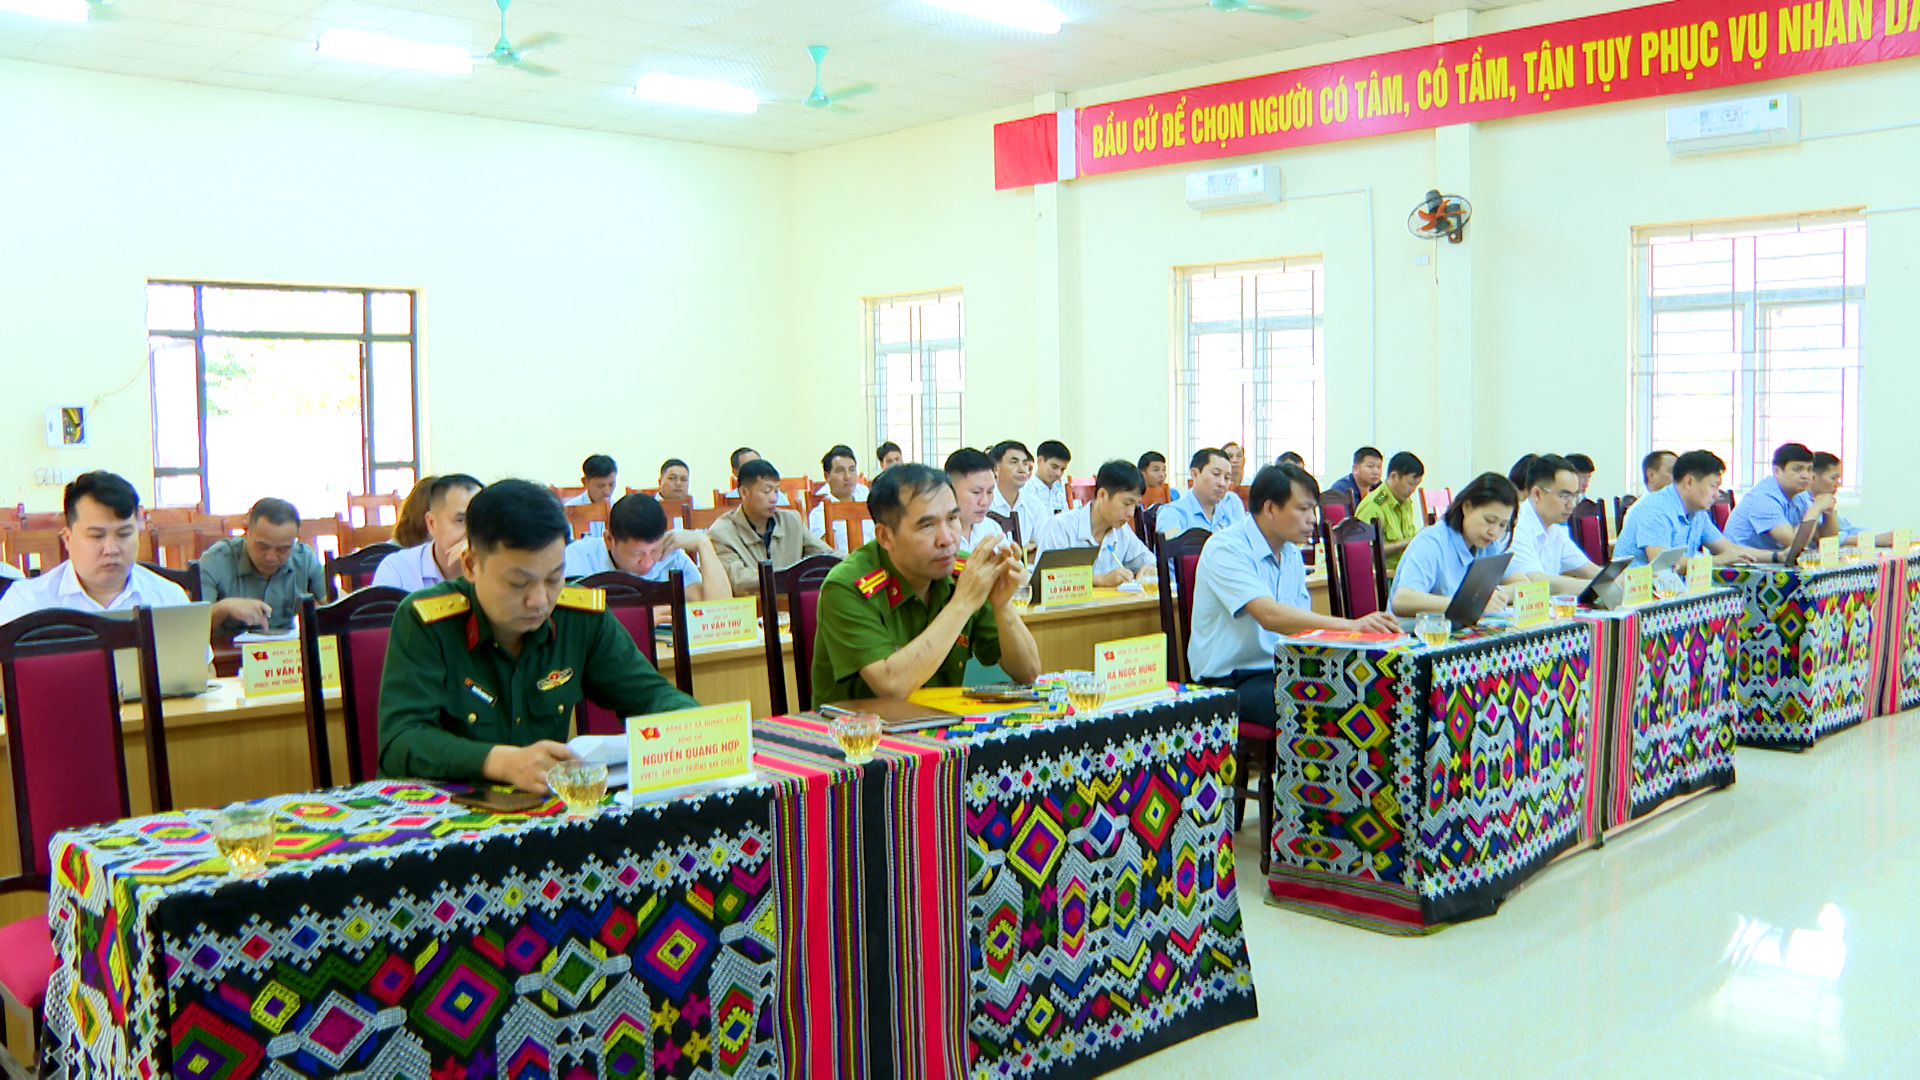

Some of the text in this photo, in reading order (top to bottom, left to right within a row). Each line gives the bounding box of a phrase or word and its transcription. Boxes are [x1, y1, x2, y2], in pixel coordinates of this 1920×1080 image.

[1093, 111, 1127, 159] BẦU
[1133, 104, 1158, 153] CỬ
[1162, 96, 1186, 148] ĐỂ
[1192, 106, 1243, 148] CHỌN
[1250, 82, 1313, 136] NGƯỜI
[1320, 76, 1348, 124] CÓ
[1354, 70, 1410, 118] TÂM,
[1417, 59, 1448, 110] CÓ
[1455, 46, 1515, 104] TẦM,
[1523, 40, 1574, 101] TẬN
[1582, 36, 1631, 92] TỤY
[1642, 21, 1718, 80] PHỤC
[1728, 12, 1767, 70] VỤ
[264, 669, 273, 677] VI
[276, 666, 294, 676] VĂN
[1118, 666, 1136, 679] NGỌC
[642, 739, 740, 766] NGUYỄN QUANG HỢP
